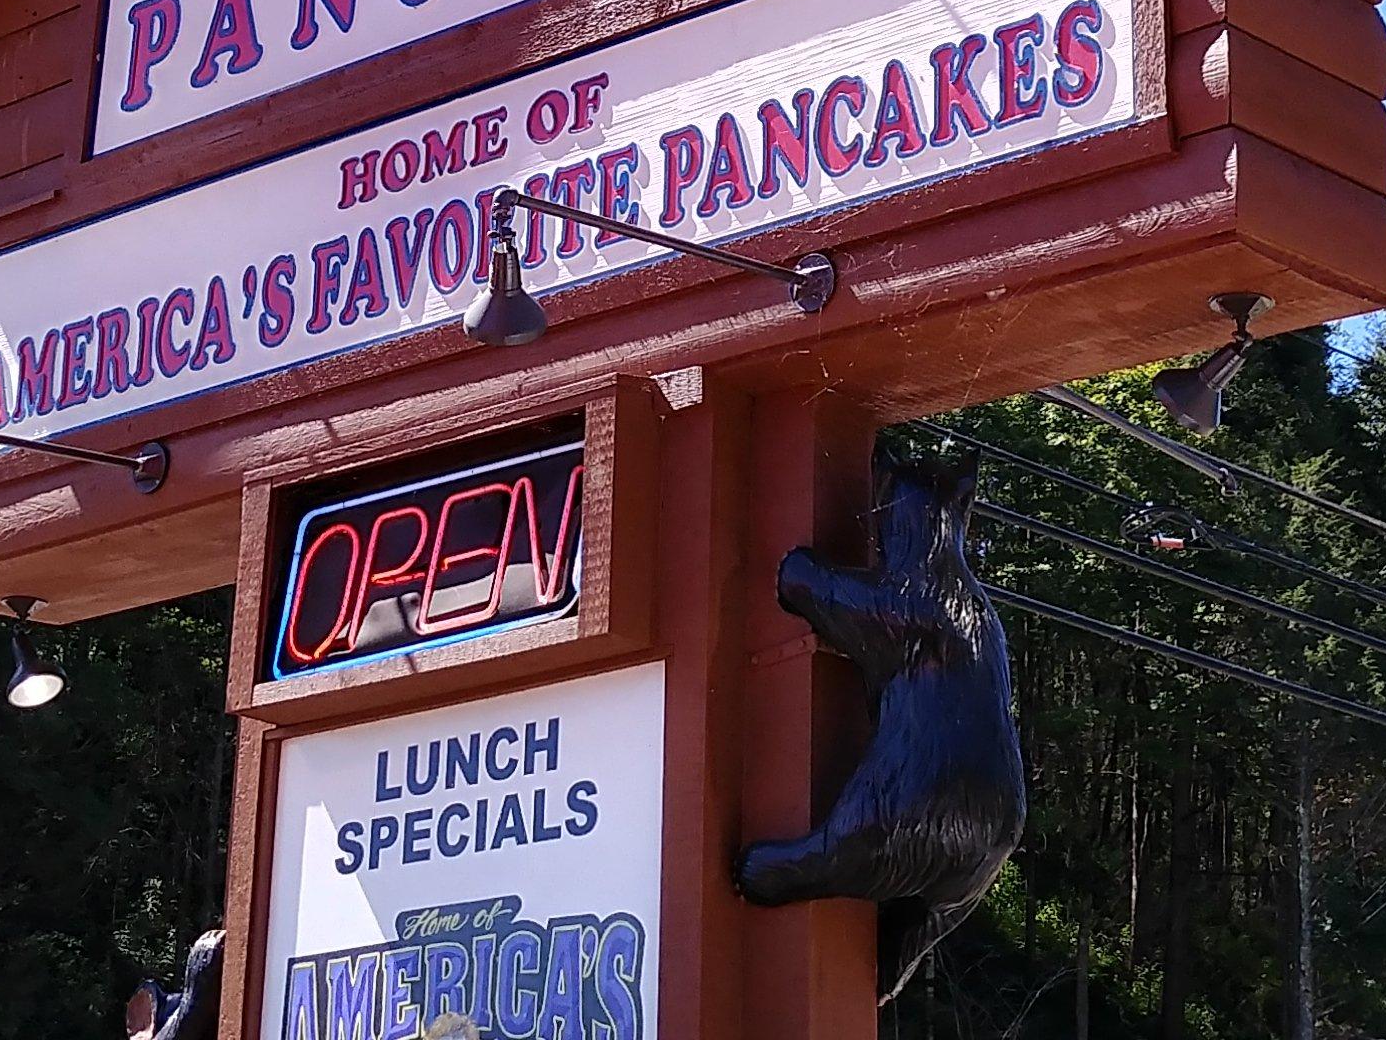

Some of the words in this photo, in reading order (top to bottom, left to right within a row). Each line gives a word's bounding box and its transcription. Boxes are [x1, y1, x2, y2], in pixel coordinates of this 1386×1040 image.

[337, 106, 509, 209] HOME
[526, 72, 610, 144] OF
[288, 465, 585, 661] OPEN
[375, 717, 560, 802] LUNCH
[335, 780, 598, 875] SPECIALS
[403, 908, 470, 940] Home
[473, 899, 513, 930] of
[282, 920, 640, 1040] AMERICA'S
